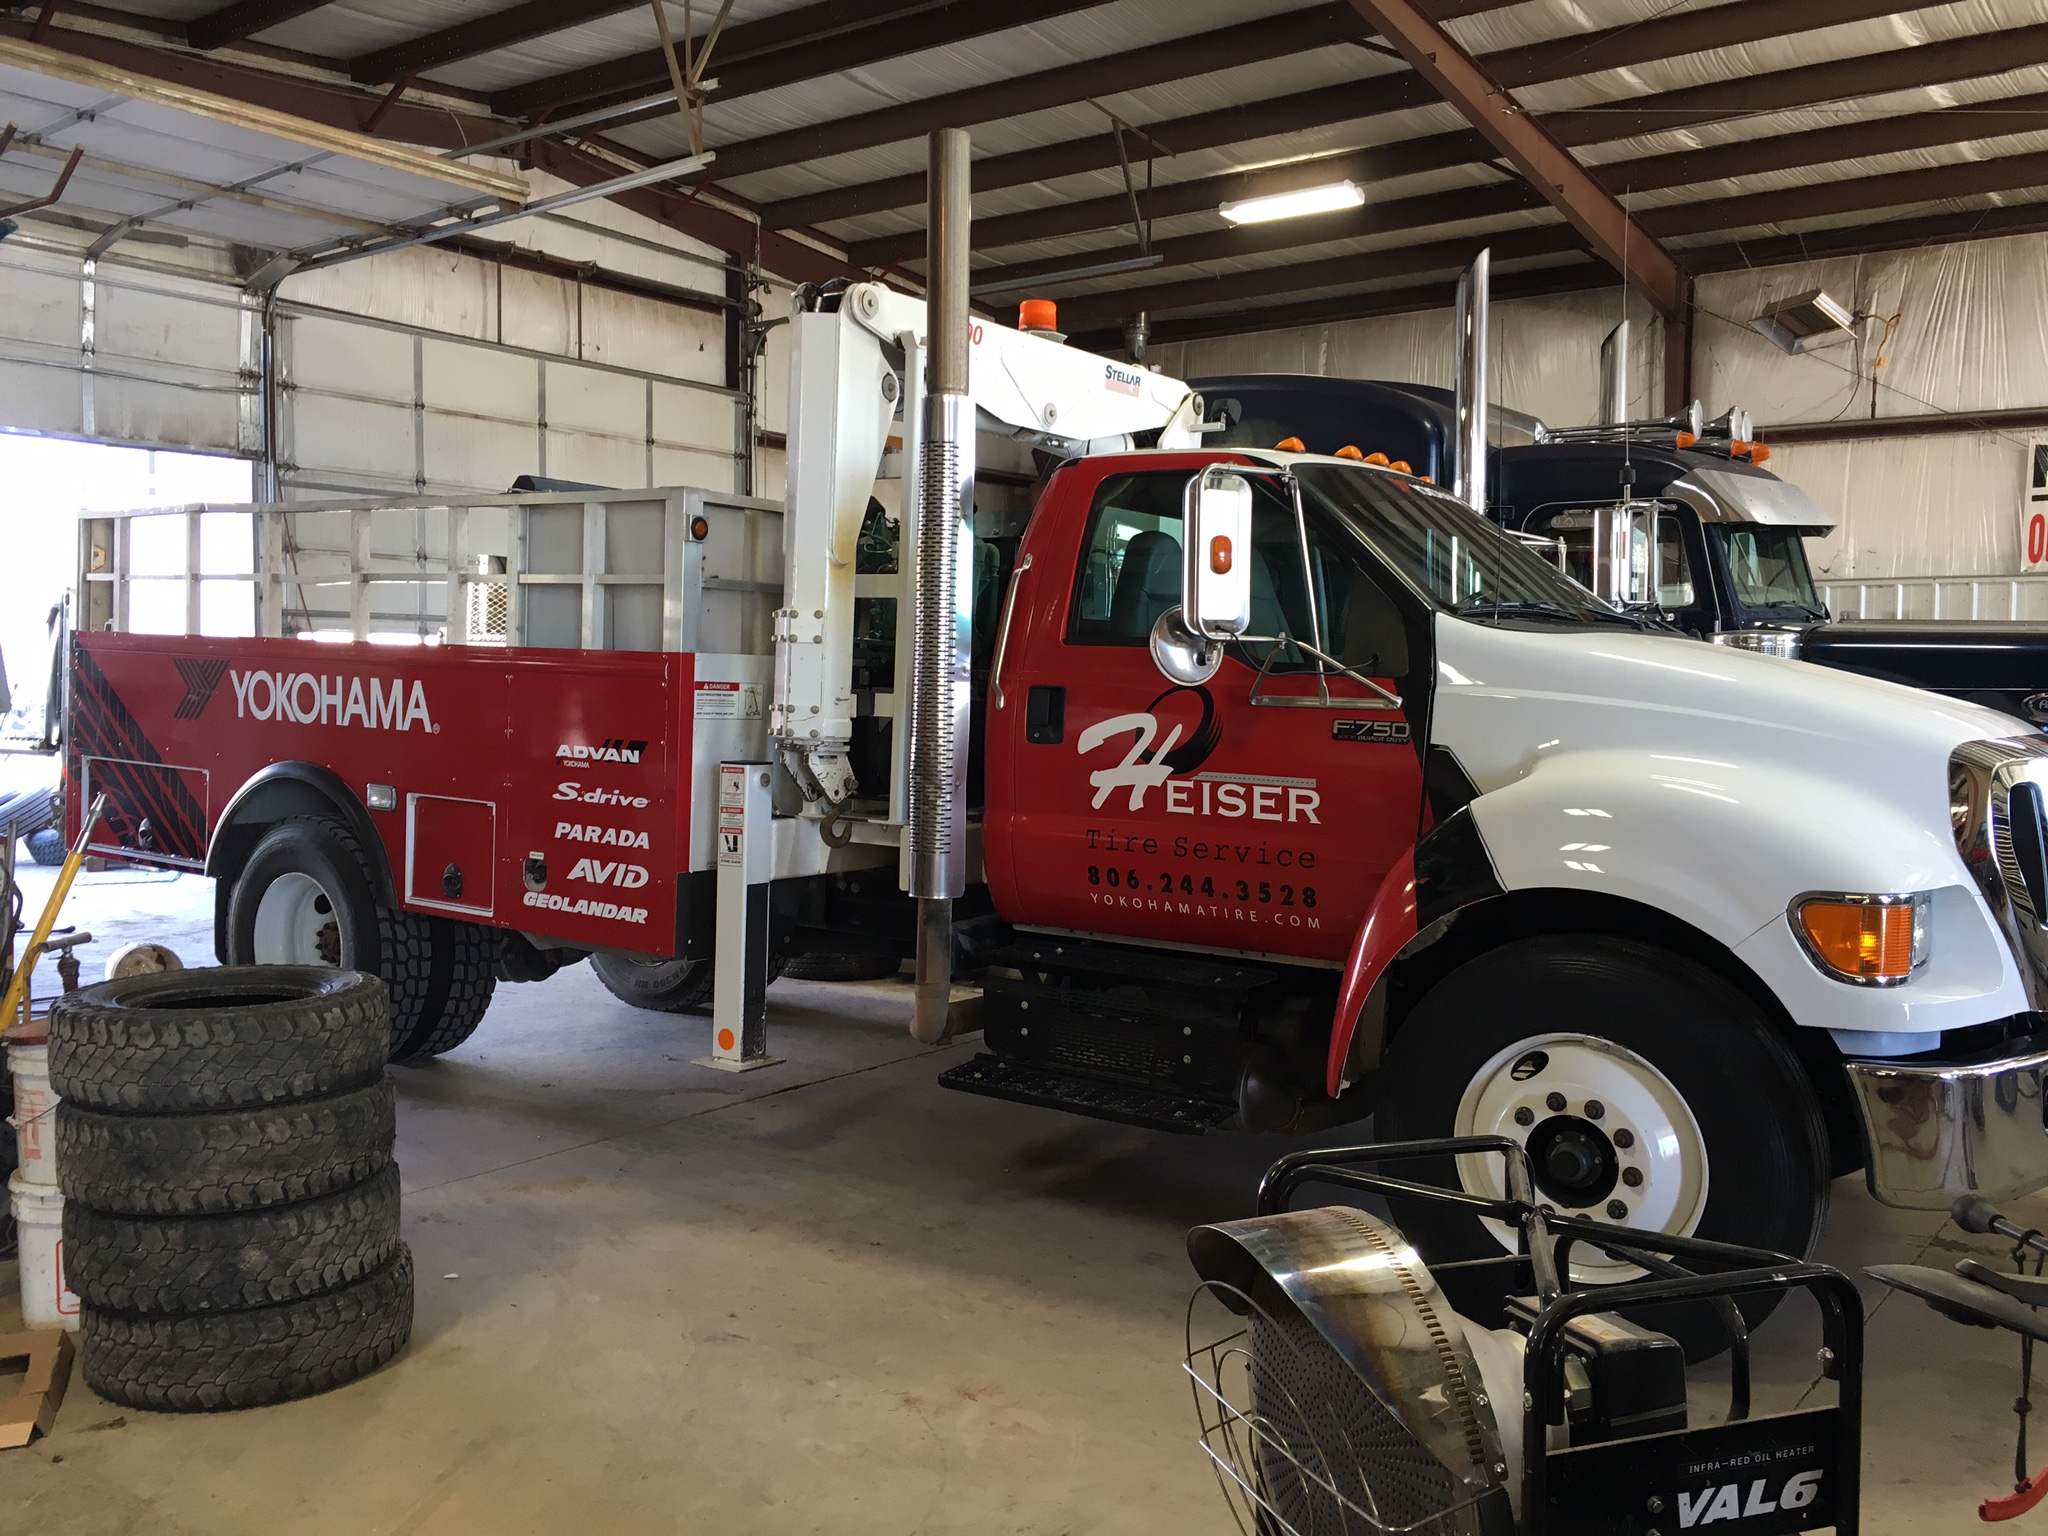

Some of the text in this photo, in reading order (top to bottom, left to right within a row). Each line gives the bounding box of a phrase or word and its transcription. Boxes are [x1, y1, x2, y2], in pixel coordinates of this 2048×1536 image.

[229, 669, 433, 733] YOKOHAMA
[555, 744, 640, 764] ADVAN
[563, 759, 590, 769] YOKOHAMA
[552, 782, 648, 809] S.drive
[554, 822, 650, 850] PARADA
[1086, 829, 1316, 869] Tire Service
[566, 858, 649, 889] AVID
[1087, 865, 1317, 908] 806.244.3528
[523, 891, 648, 924] GEOLANDAR
[1090, 892, 1321, 930] YOKOHAMATIRE.COM
[1754, 1452, 1772, 1462] OIL
[1775, 1446, 1815, 1459] HEATER
[1677, 1469, 1824, 1529] VAL6
